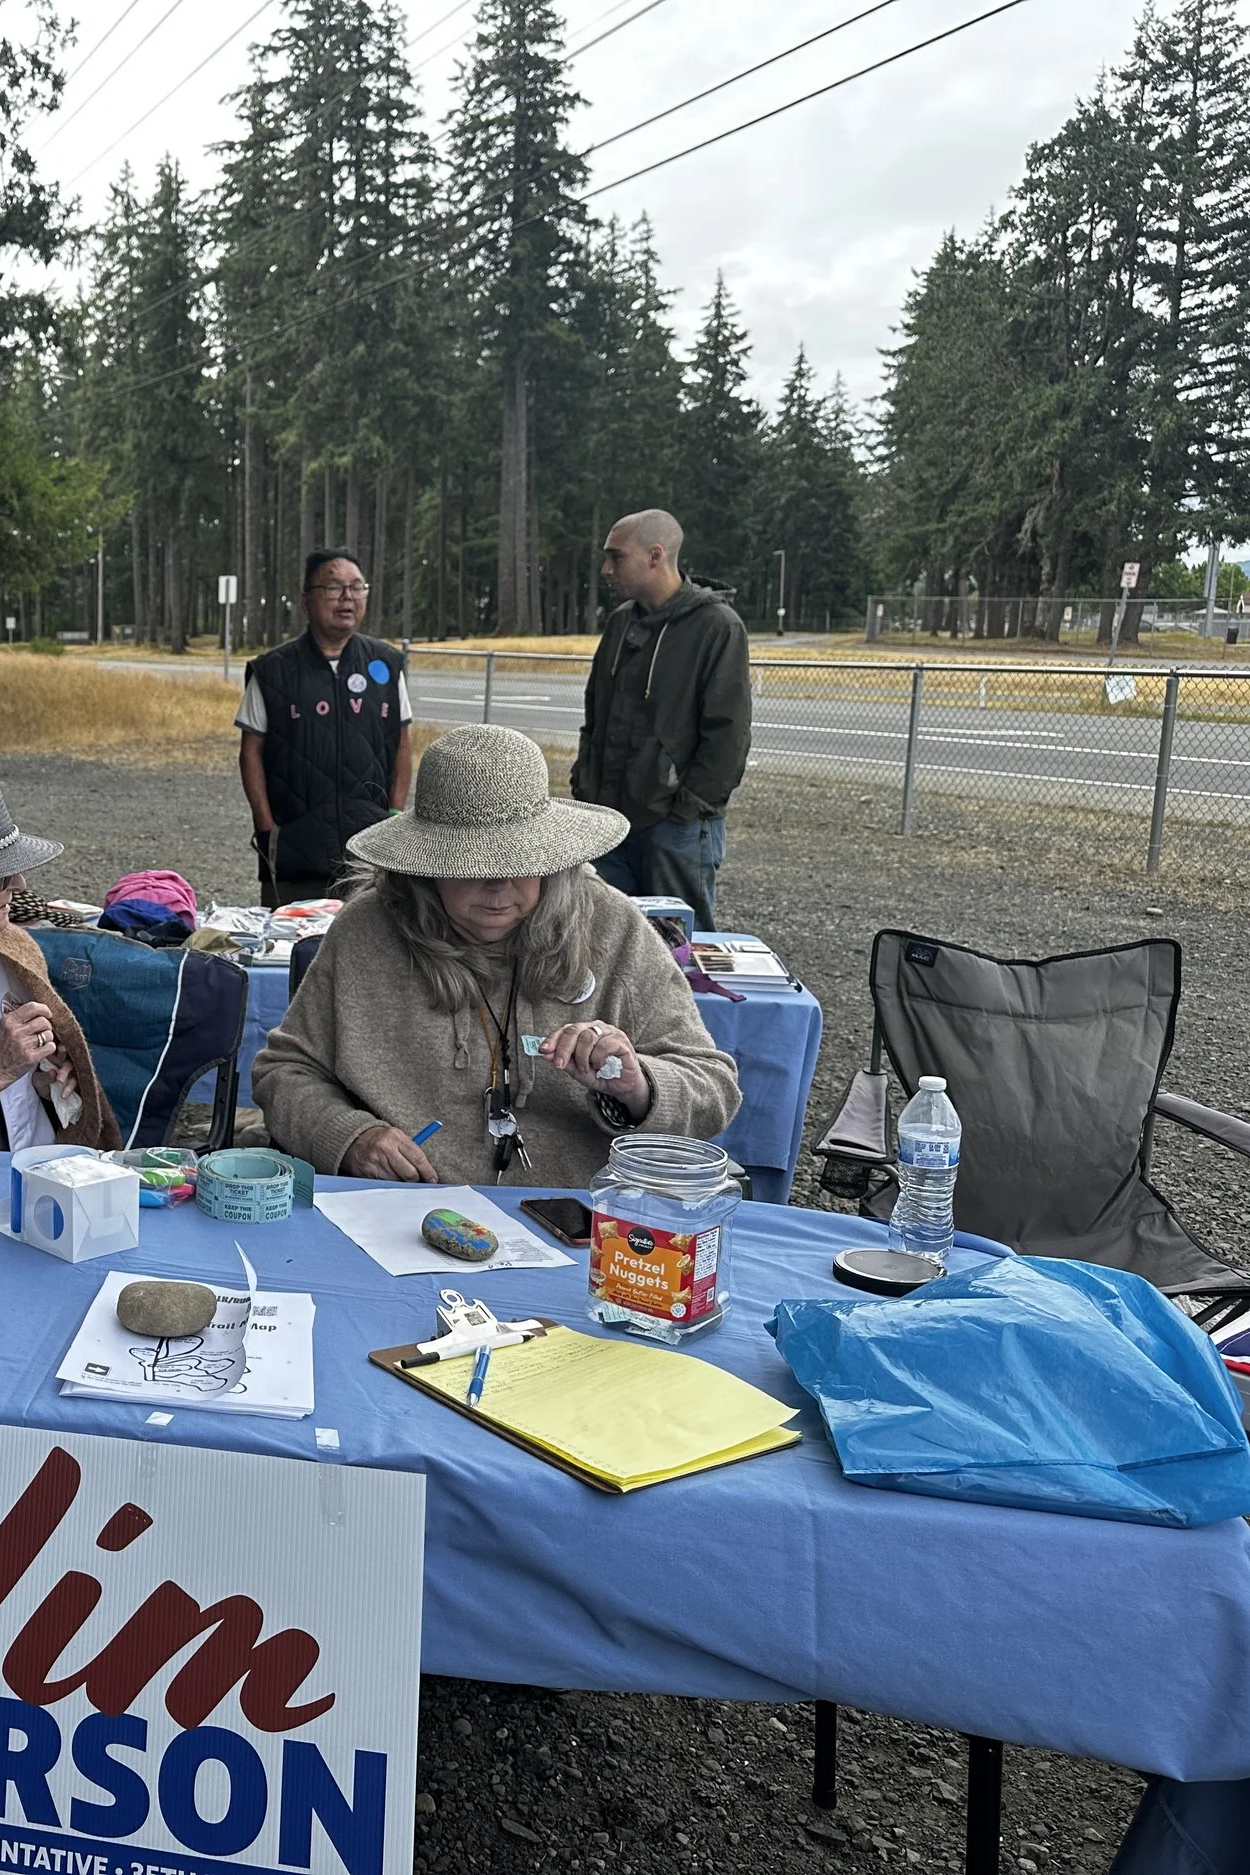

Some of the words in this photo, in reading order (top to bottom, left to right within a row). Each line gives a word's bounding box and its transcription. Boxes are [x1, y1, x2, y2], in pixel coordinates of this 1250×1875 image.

[270, 1186, 286, 1194] TICKET
[224, 1210, 252, 1220] COUPON
[266, 1208, 287, 1220] COUPON
[614, 1250, 665, 1276] Pretzel
[609, 1263, 669, 1290] Nuggets
